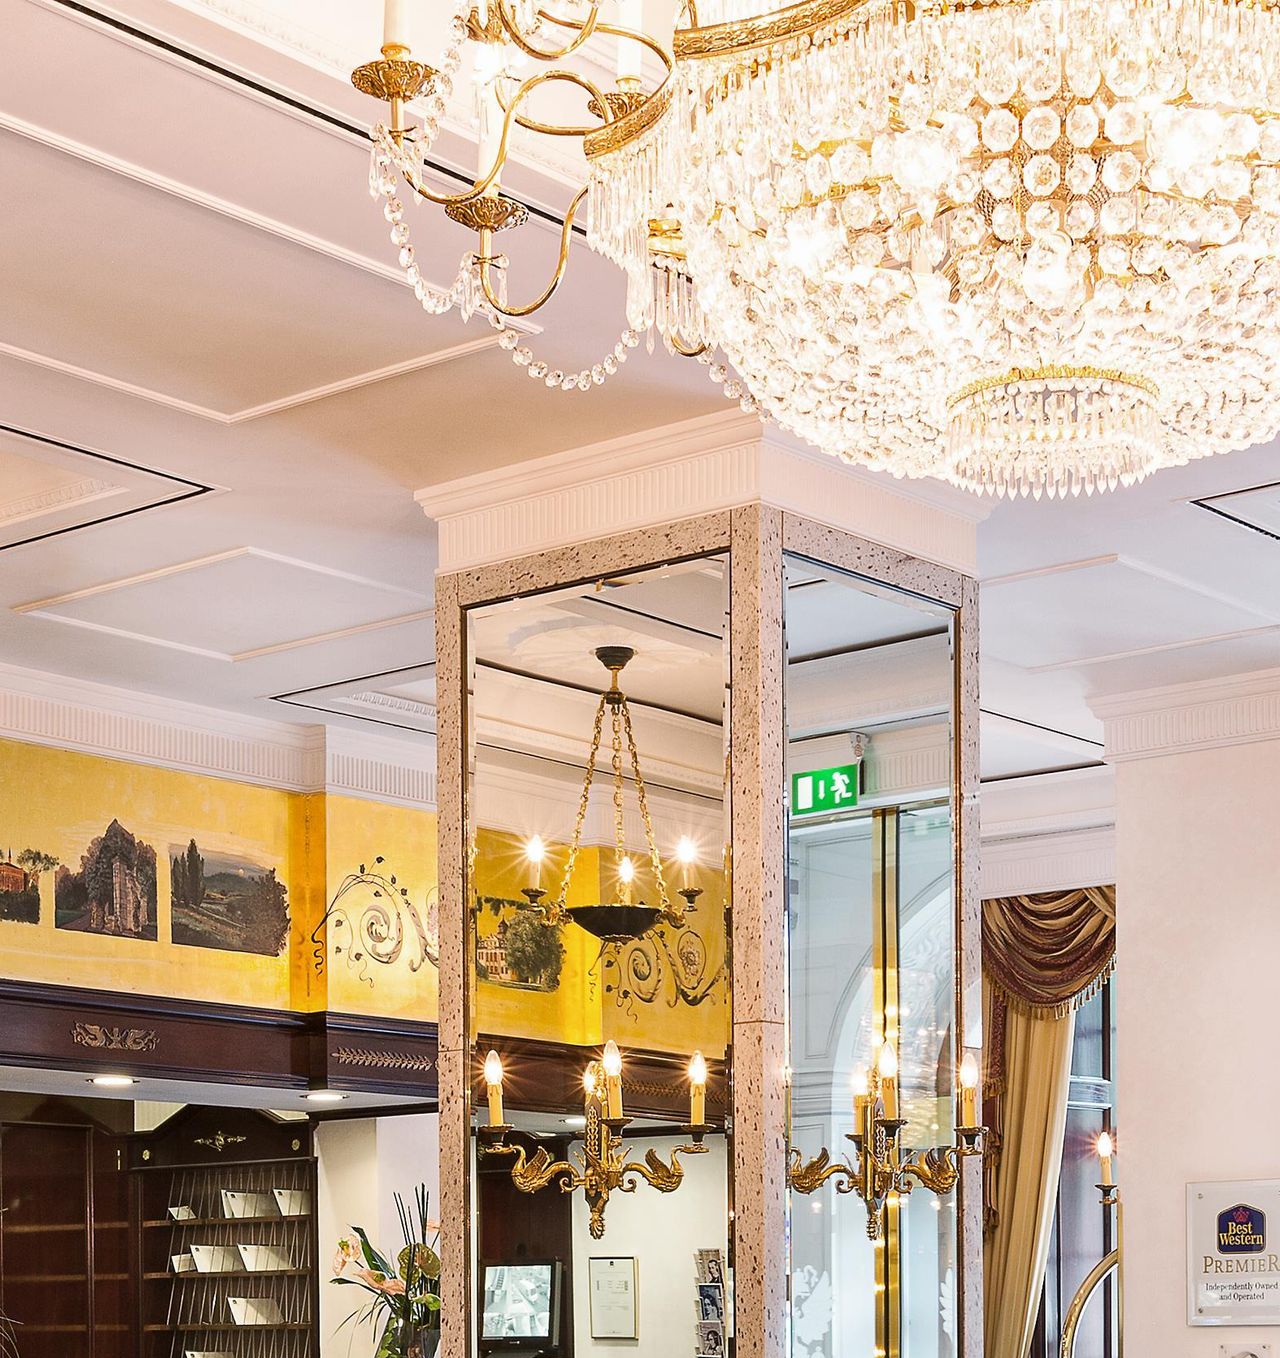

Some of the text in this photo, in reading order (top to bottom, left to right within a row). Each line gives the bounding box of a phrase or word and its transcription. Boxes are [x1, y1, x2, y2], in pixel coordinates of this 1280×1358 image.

[1227, 1221, 1253, 1235] Best
[1218, 1233, 1264, 1246] Western
[1202, 1254, 1280, 1274] PREMIER
[1205, 1282, 1279, 1292] Independently Owned
[1219, 1292, 1265, 1302] and Operated
